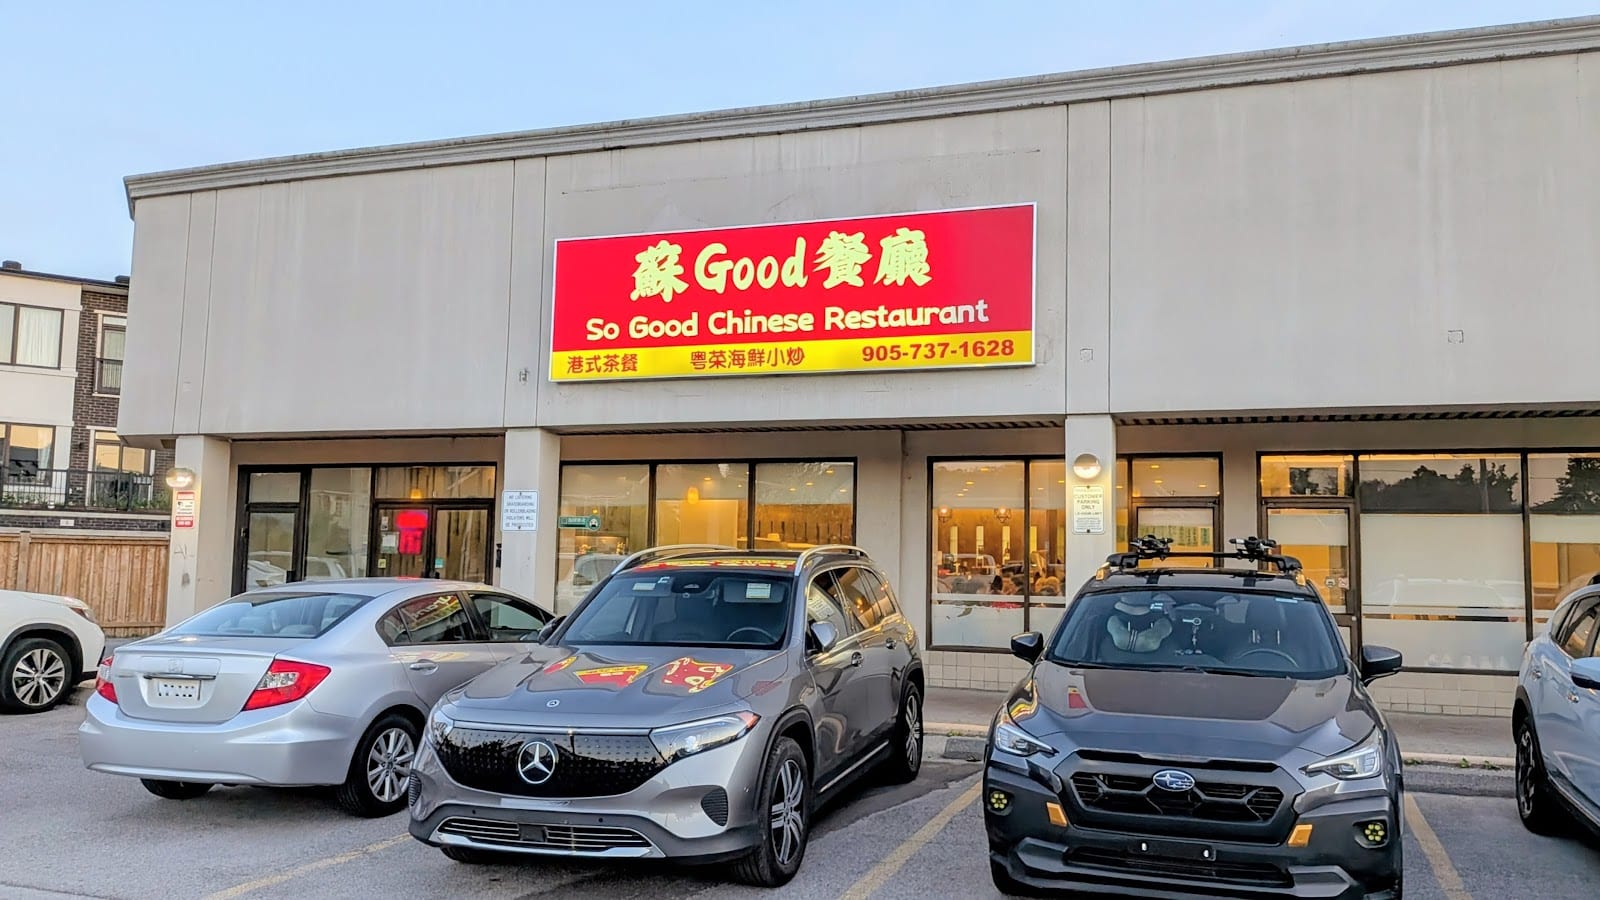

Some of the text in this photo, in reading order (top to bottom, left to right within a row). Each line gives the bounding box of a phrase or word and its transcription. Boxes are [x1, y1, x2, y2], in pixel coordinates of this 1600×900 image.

[586, 299, 990, 341] So Good Chinese Restaurant
[861, 339, 1015, 362] 905-737-1628
[567, 353, 638, 374] 港式茶餐
